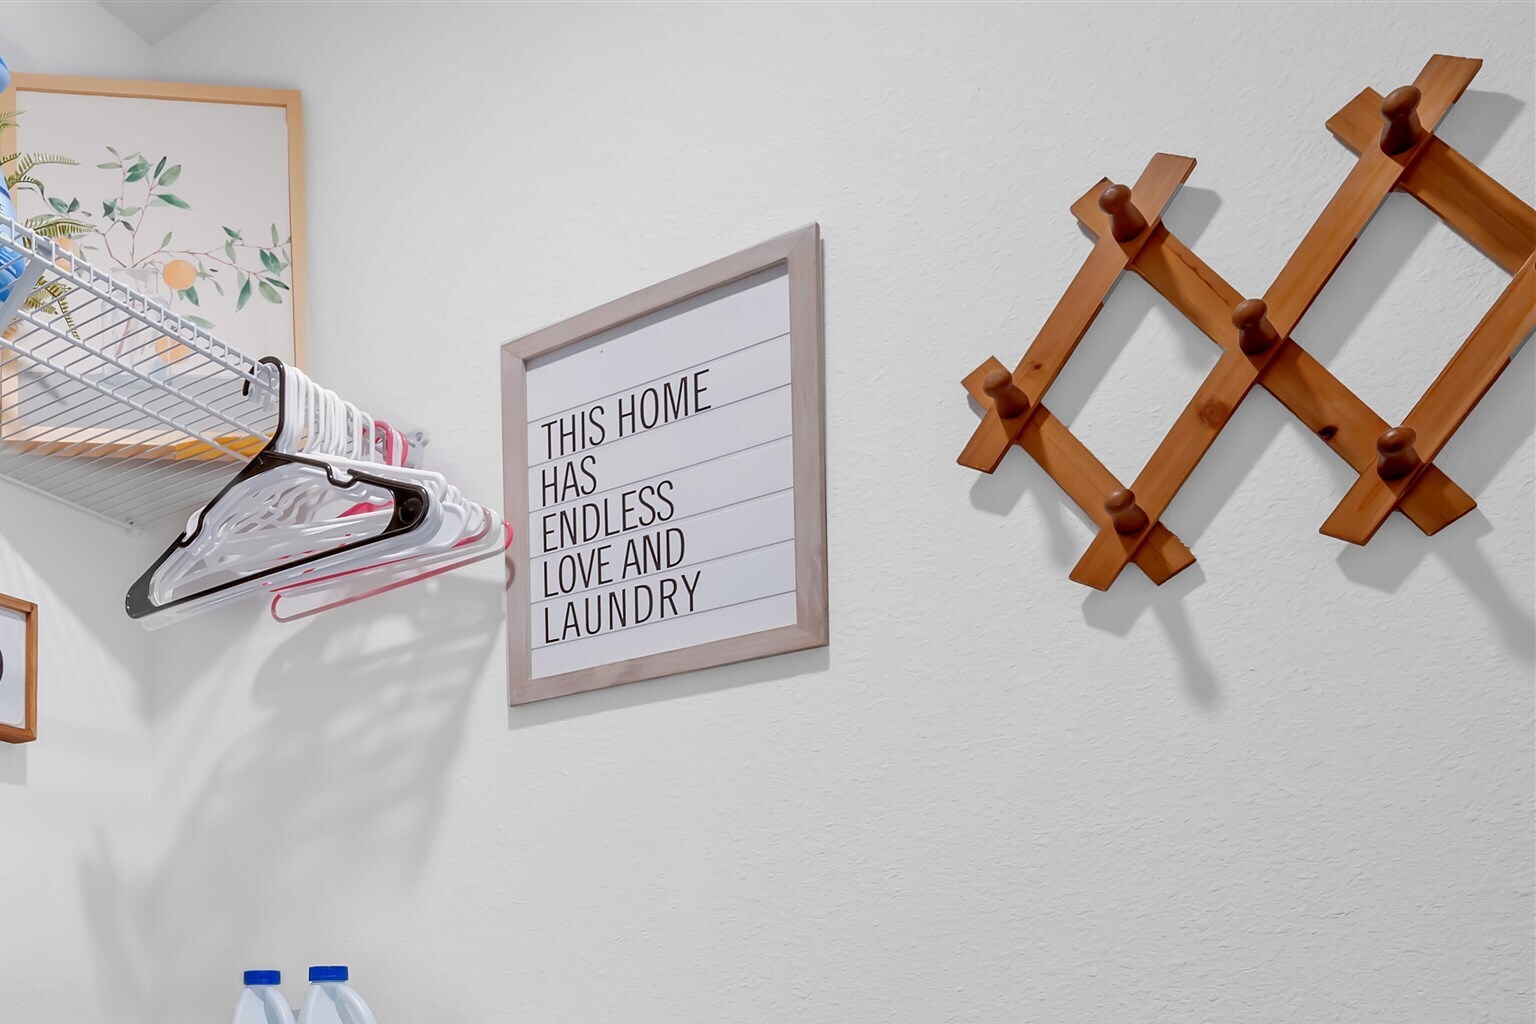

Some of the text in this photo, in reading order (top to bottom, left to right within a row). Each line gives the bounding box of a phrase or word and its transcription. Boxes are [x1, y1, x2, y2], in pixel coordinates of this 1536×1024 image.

[541, 368, 712, 460] THIS HOME
[541, 455, 597, 507] HAS
[542, 479, 674, 553] ENDLESS
[543, 527, 686, 598] LOVE AND
[544, 571, 702, 644] LAUNDRY
